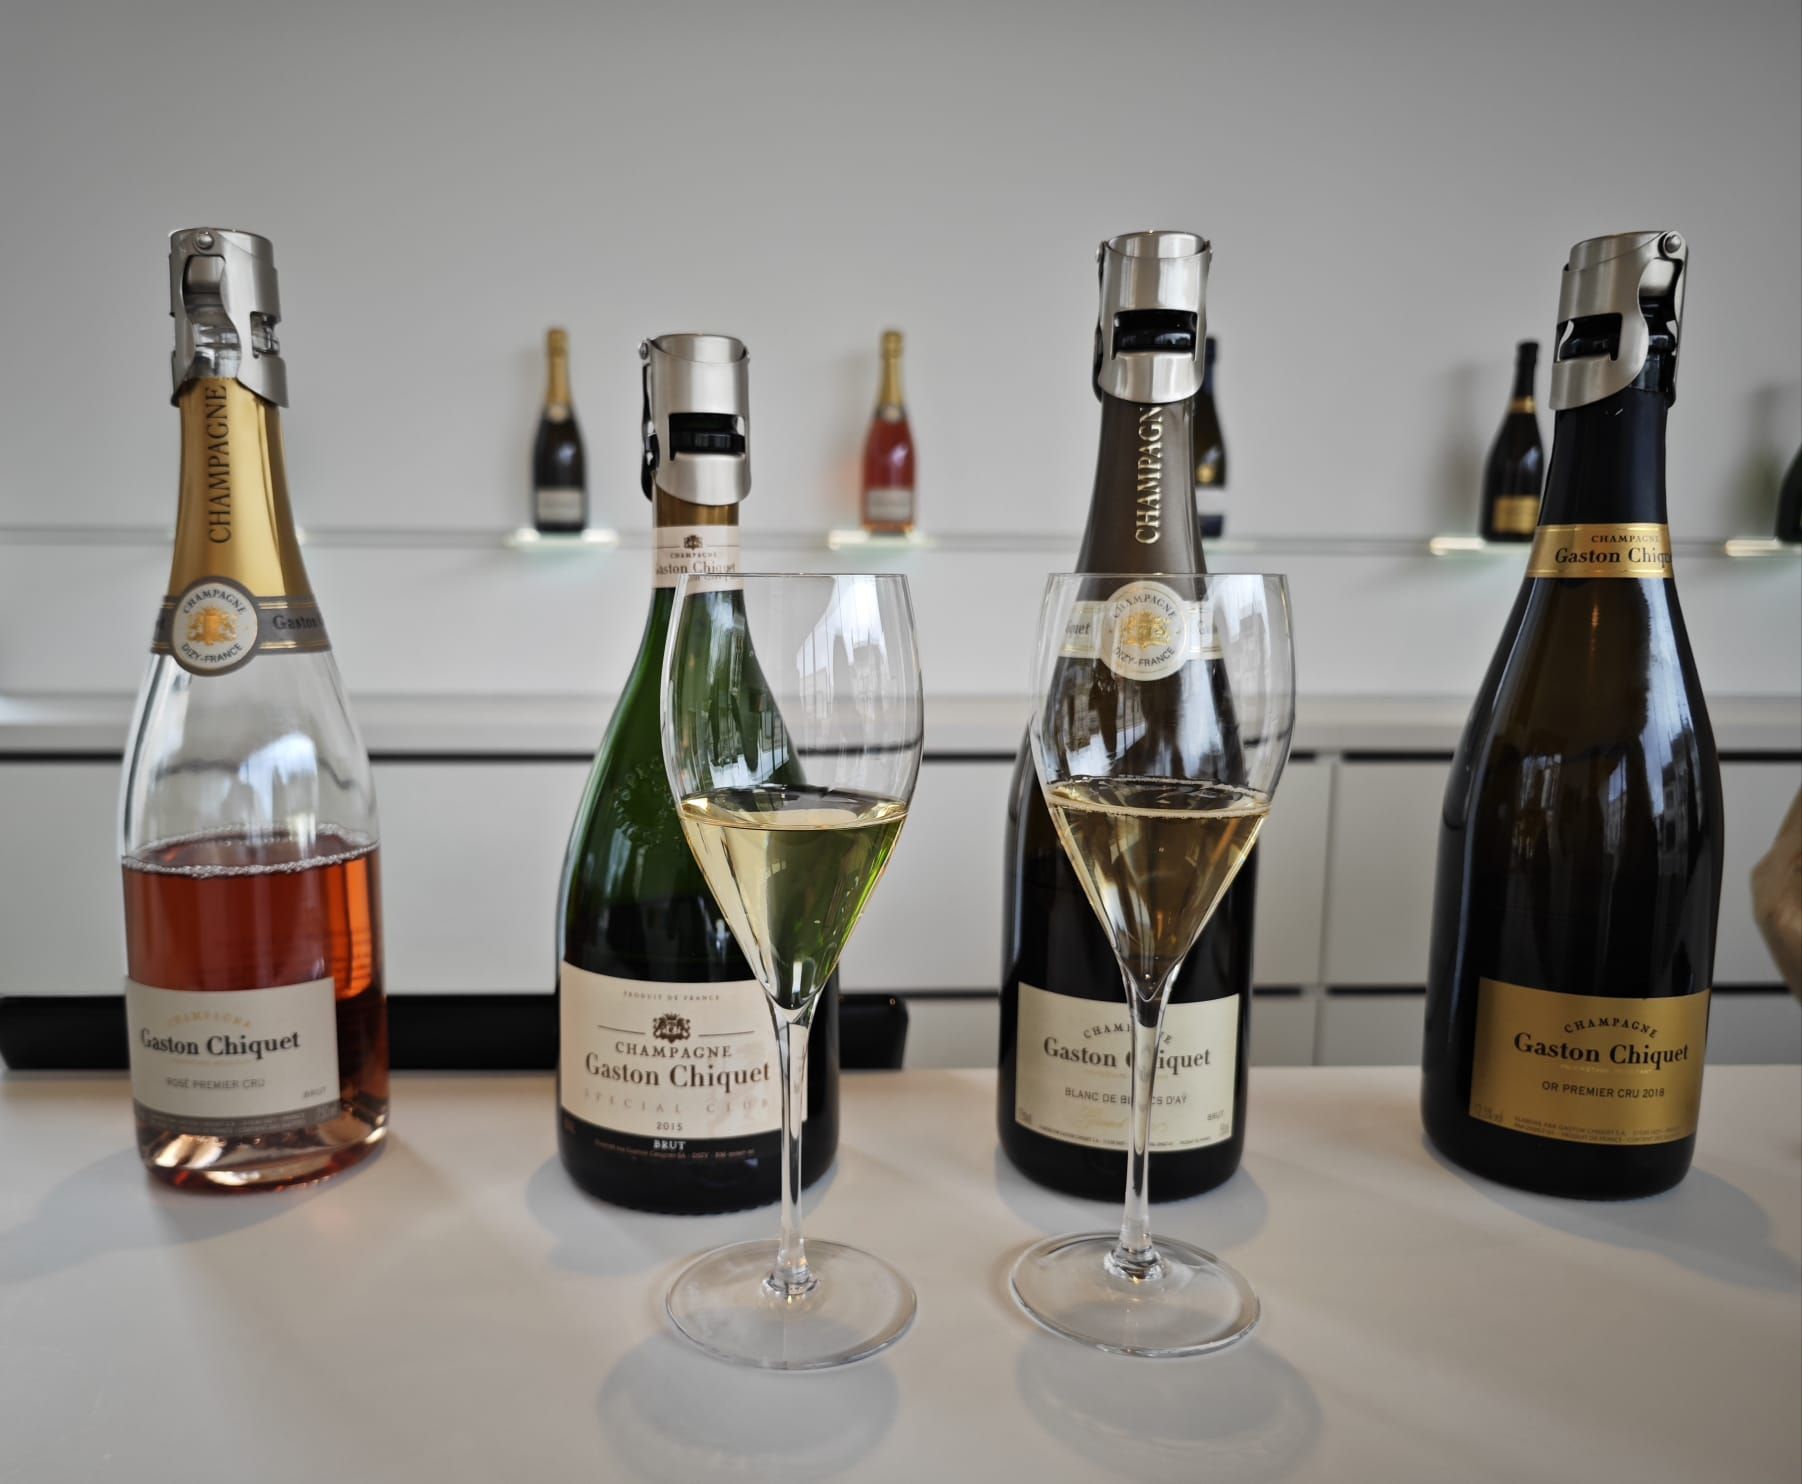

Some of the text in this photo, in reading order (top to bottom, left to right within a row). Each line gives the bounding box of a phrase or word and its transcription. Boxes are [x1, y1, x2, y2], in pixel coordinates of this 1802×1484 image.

[206, 384, 233, 544] CHAMPAGNE
[1135, 406, 1163, 545] CHAMPAGN
[1591, 535, 1660, 544] CHAMPAGNE
[656, 562, 688, 575] aston
[1555, 547, 1672, 570] Gaston Chiqu
[184, 588, 248, 615] CHAMPAGNE
[1111, 593, 1177, 619] CHAMPAGNE
[622, 990, 721, 1002] PRODUIT DE FRANCE
[1563, 1017, 1659, 1039] CHAMPAGNE
[140, 1028, 301, 1061] Gaston Chiquet
[615, 1040, 733, 1060] CHAMPAGNE
[1513, 1032, 1689, 1071] Gaston Chiquet
[1043, 1036, 1212, 1076] Gaston iquet
[165, 1077, 266, 1091] ROSÉ PREMIER CRU
[585, 1052, 770, 1094] Gaston Chiquet
[1064, 1087, 1099, 1103] BLANC
[1102, 1091, 1117, 1103] DE
[1120, 1092, 1163, 1105] BLCS
[1541, 1080, 1666, 1099] OR PREMIER CRU 2018
[656, 1121, 684, 1132] 2015
[653, 1140, 686, 1151] BRUT
